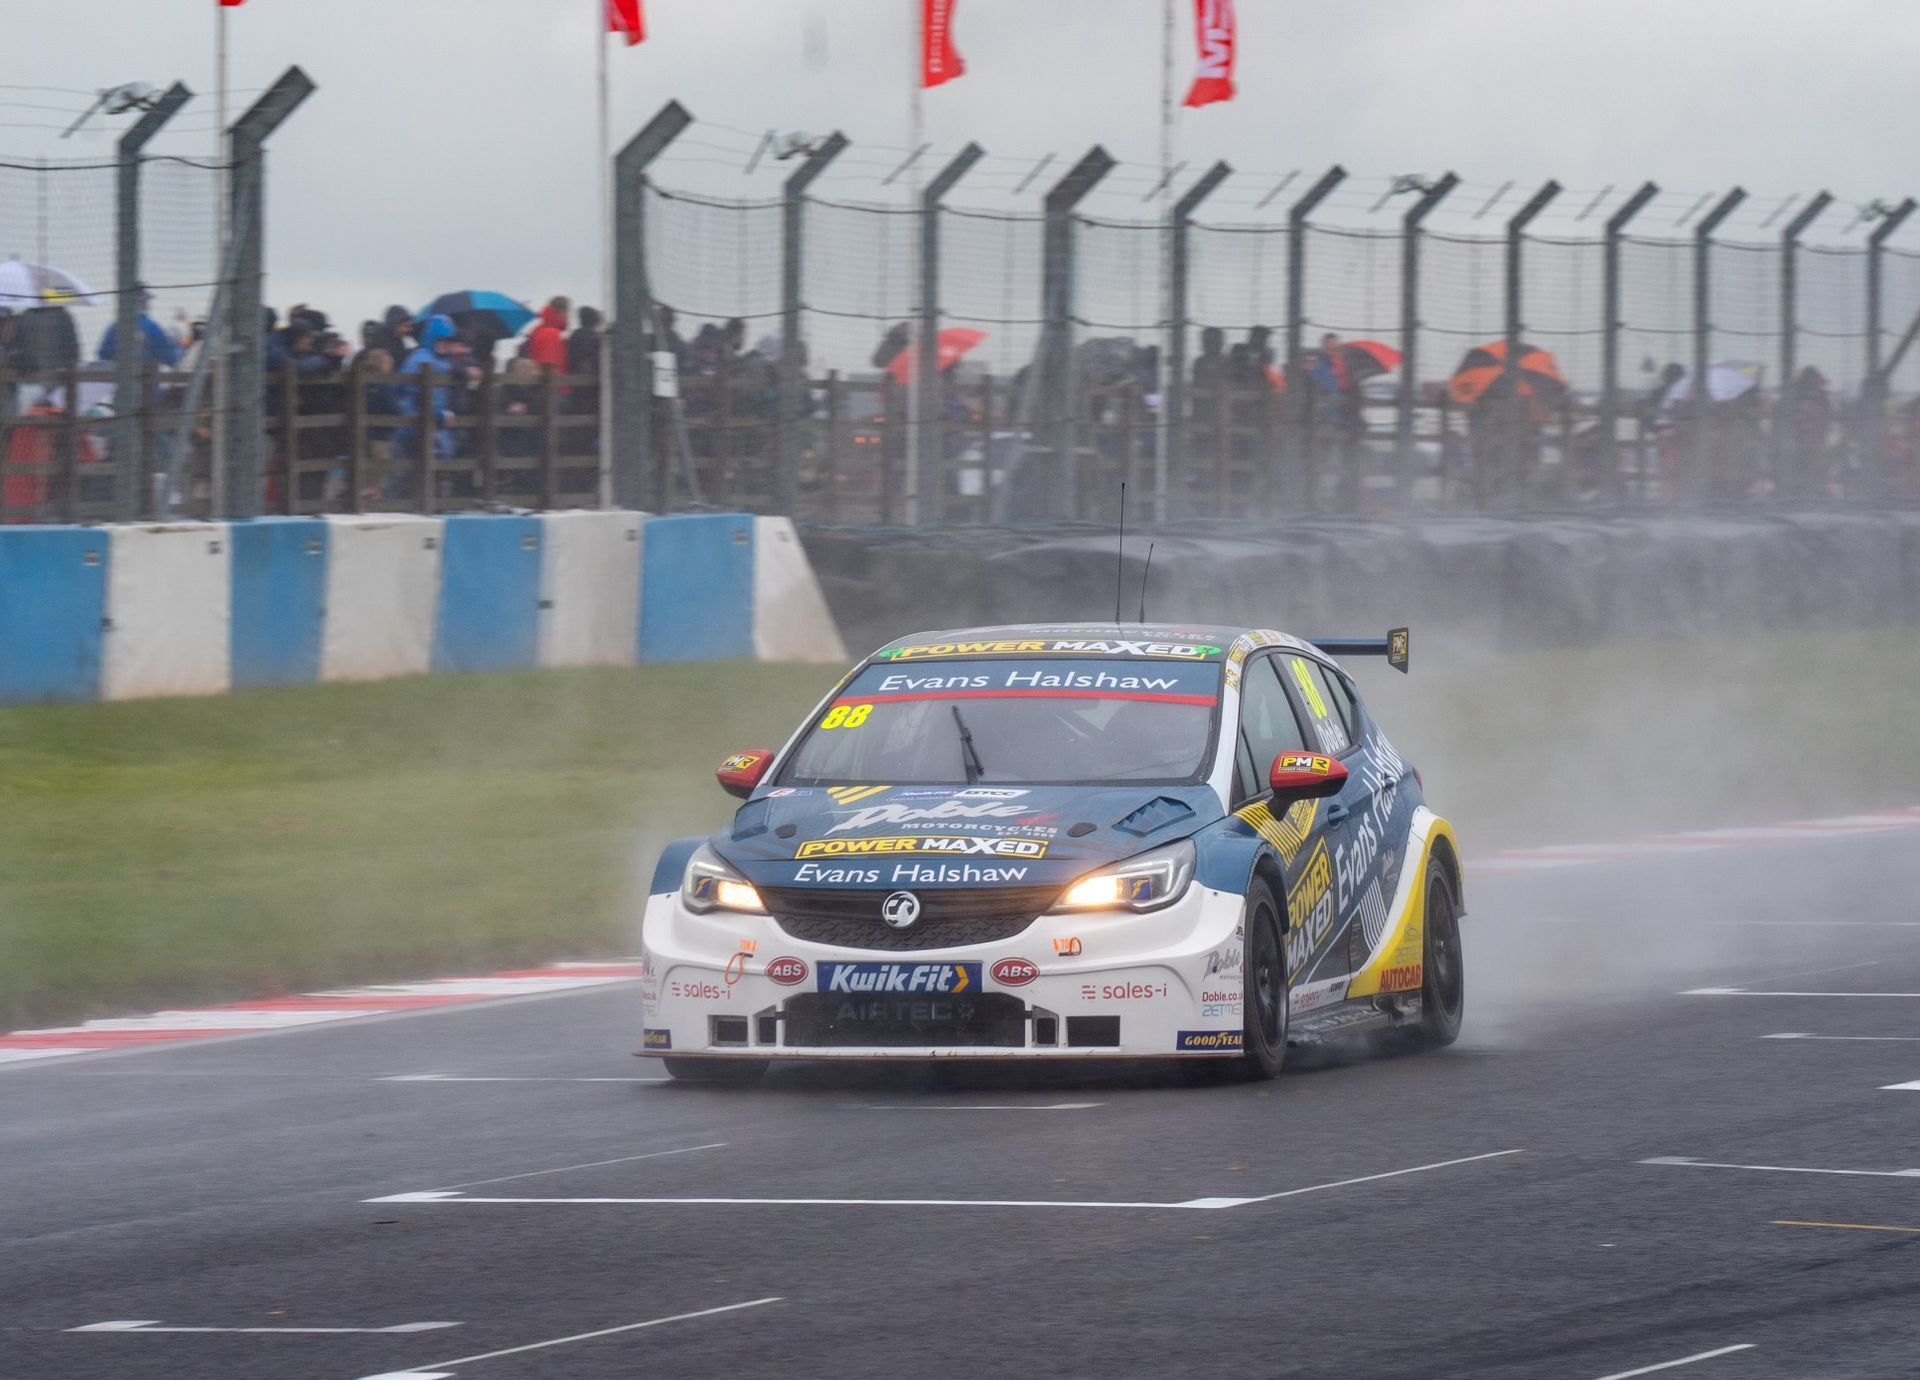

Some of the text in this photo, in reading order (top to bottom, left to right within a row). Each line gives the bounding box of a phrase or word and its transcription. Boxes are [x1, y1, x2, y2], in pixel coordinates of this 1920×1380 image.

[901, 640, 1203, 657] POWER MAXED
[878, 671, 1179, 692] Evans Halshaw
[821, 704, 873, 729] 88
[1282, 757, 1328, 768] PMR
[823, 801, 1044, 836] Doble
[899, 821, 1058, 836] MOTORCYCLES
[803, 838, 1041, 856] POWER MAXED
[1335, 811, 1378, 915] Evans
[793, 863, 1029, 884] Evans Halshaw
[1287, 853, 1331, 928] POWER
[1287, 890, 1335, 975] MAXED
[771, 963, 802, 977] ABS
[998, 965, 1032, 978] ABS
[1379, 965, 1421, 991] AUTOCAR
[683, 982, 731, 1000] sales-i
[1102, 982, 1167, 1000] sales-i
